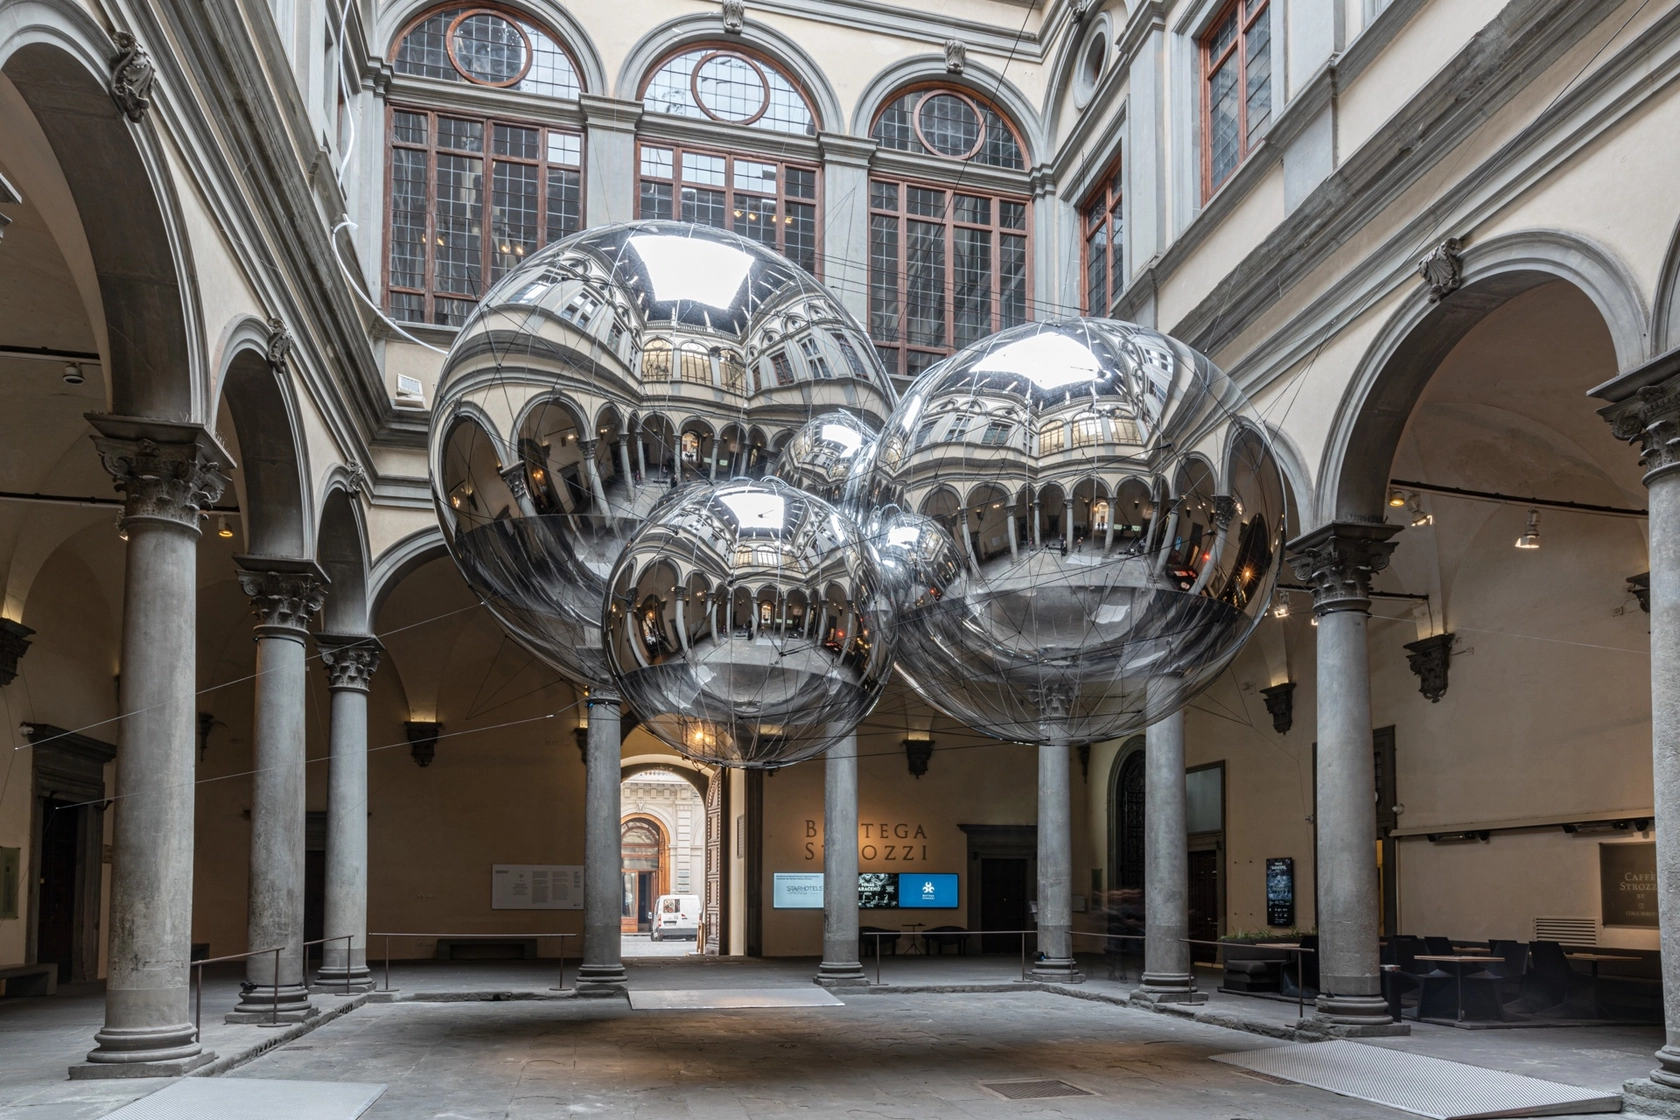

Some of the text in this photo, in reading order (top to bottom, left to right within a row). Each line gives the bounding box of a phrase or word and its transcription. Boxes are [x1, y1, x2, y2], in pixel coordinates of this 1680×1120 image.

[805, 820, 927, 839] BTEGA
[805, 842, 927, 861] SOZZI
[1620, 882, 1658, 891] STROZZ
